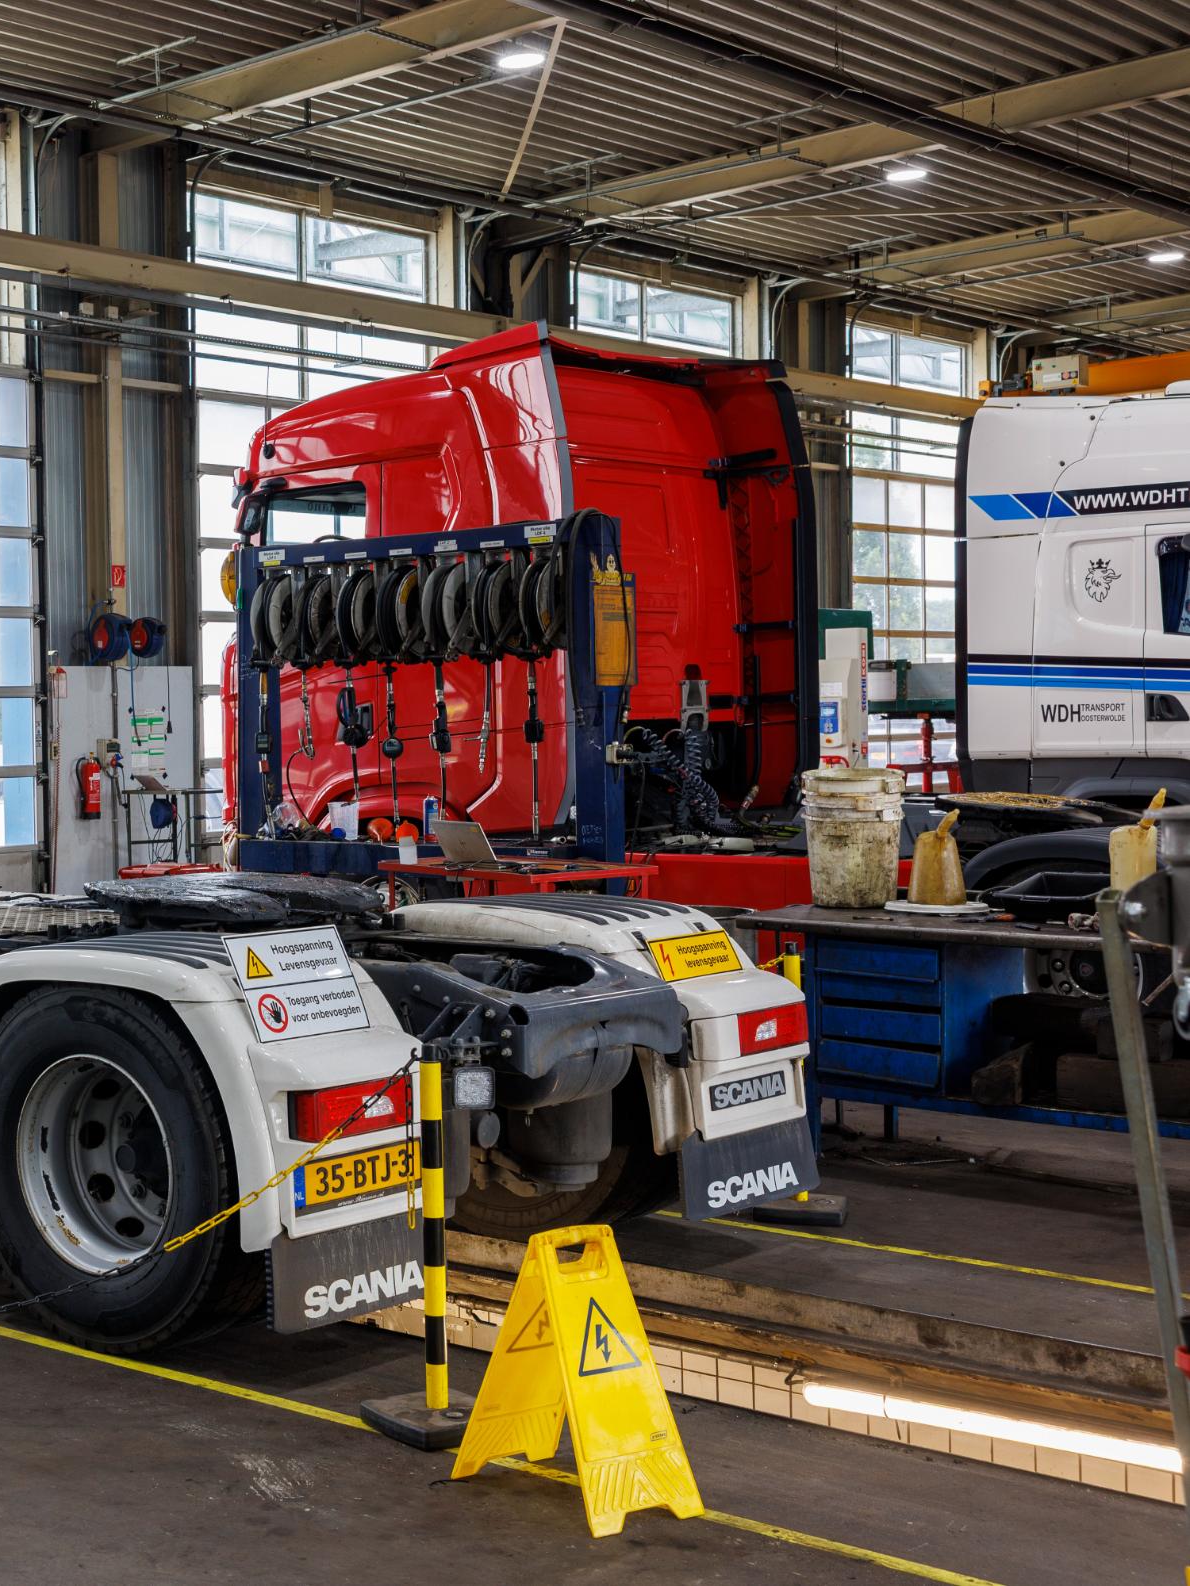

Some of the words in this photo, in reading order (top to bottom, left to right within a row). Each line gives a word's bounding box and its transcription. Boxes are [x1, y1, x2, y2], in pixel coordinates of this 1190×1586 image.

[1041, 704, 1081, 723] WDH
[1081, 703, 1126, 712] TRANSPORT
[1080, 714, 1126, 722] OOSTERWOLDE
[270, 939, 334, 955] Hoogspanning
[676, 940, 727, 955] Hoogspanning
[278, 956, 338, 972] Levensgevaar
[685, 954, 729, 968] levensgevaar
[285, 994, 320, 1007] Toegang
[321, 989, 356, 1002] verboden
[291, 1013, 309, 1023] voor
[309, 1005, 362, 1020] onbevoegden
[714, 1073, 786, 1109] SCANIA
[294, 1192, 305, 1201] NL
[315, 1148, 410, 1197] 35-BTJ-3
[707, 1161, 800, 1209] SCANIA
[304, 1259, 425, 1319] SCANIA
